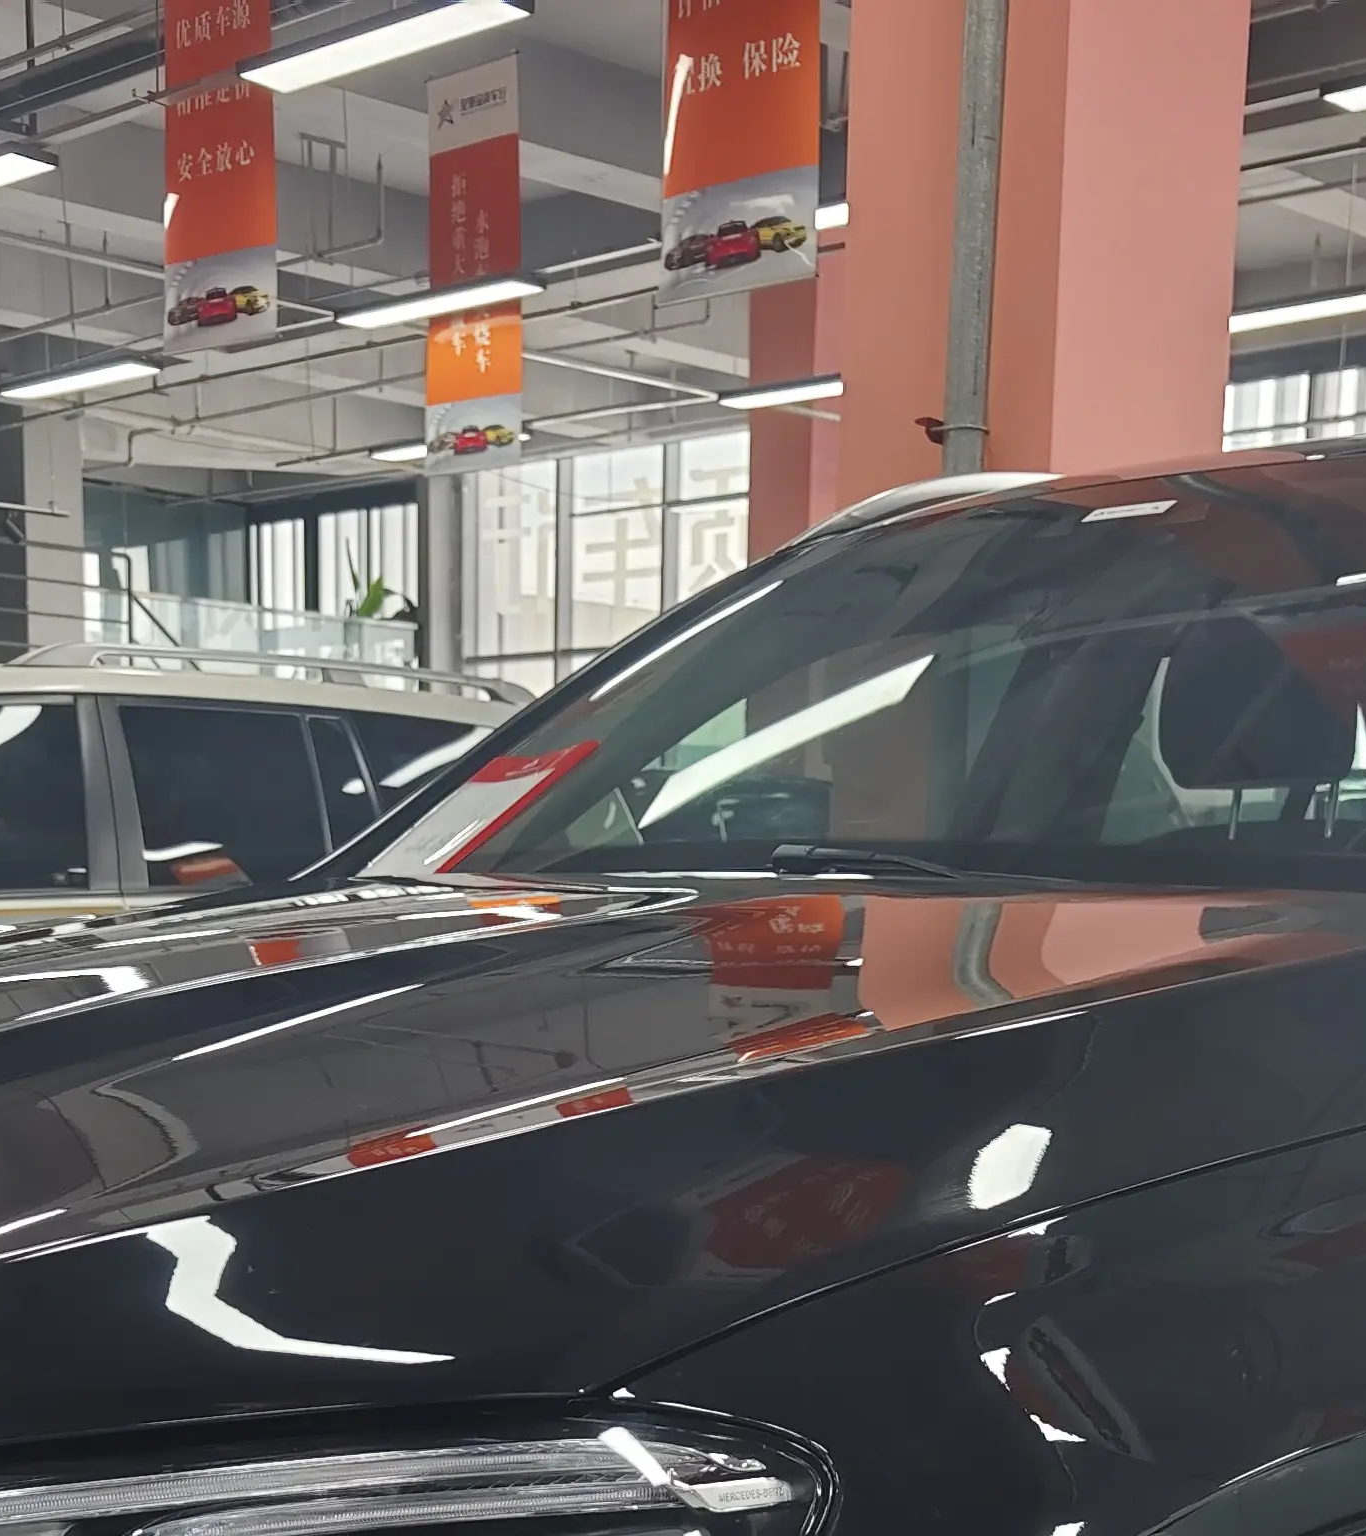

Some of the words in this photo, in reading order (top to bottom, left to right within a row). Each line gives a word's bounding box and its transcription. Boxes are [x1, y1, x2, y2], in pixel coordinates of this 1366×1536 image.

[175, 0, 251, 50] 优质车源
[743, 32, 802, 80] 保险
[177, 139, 255, 183] 安全放心
